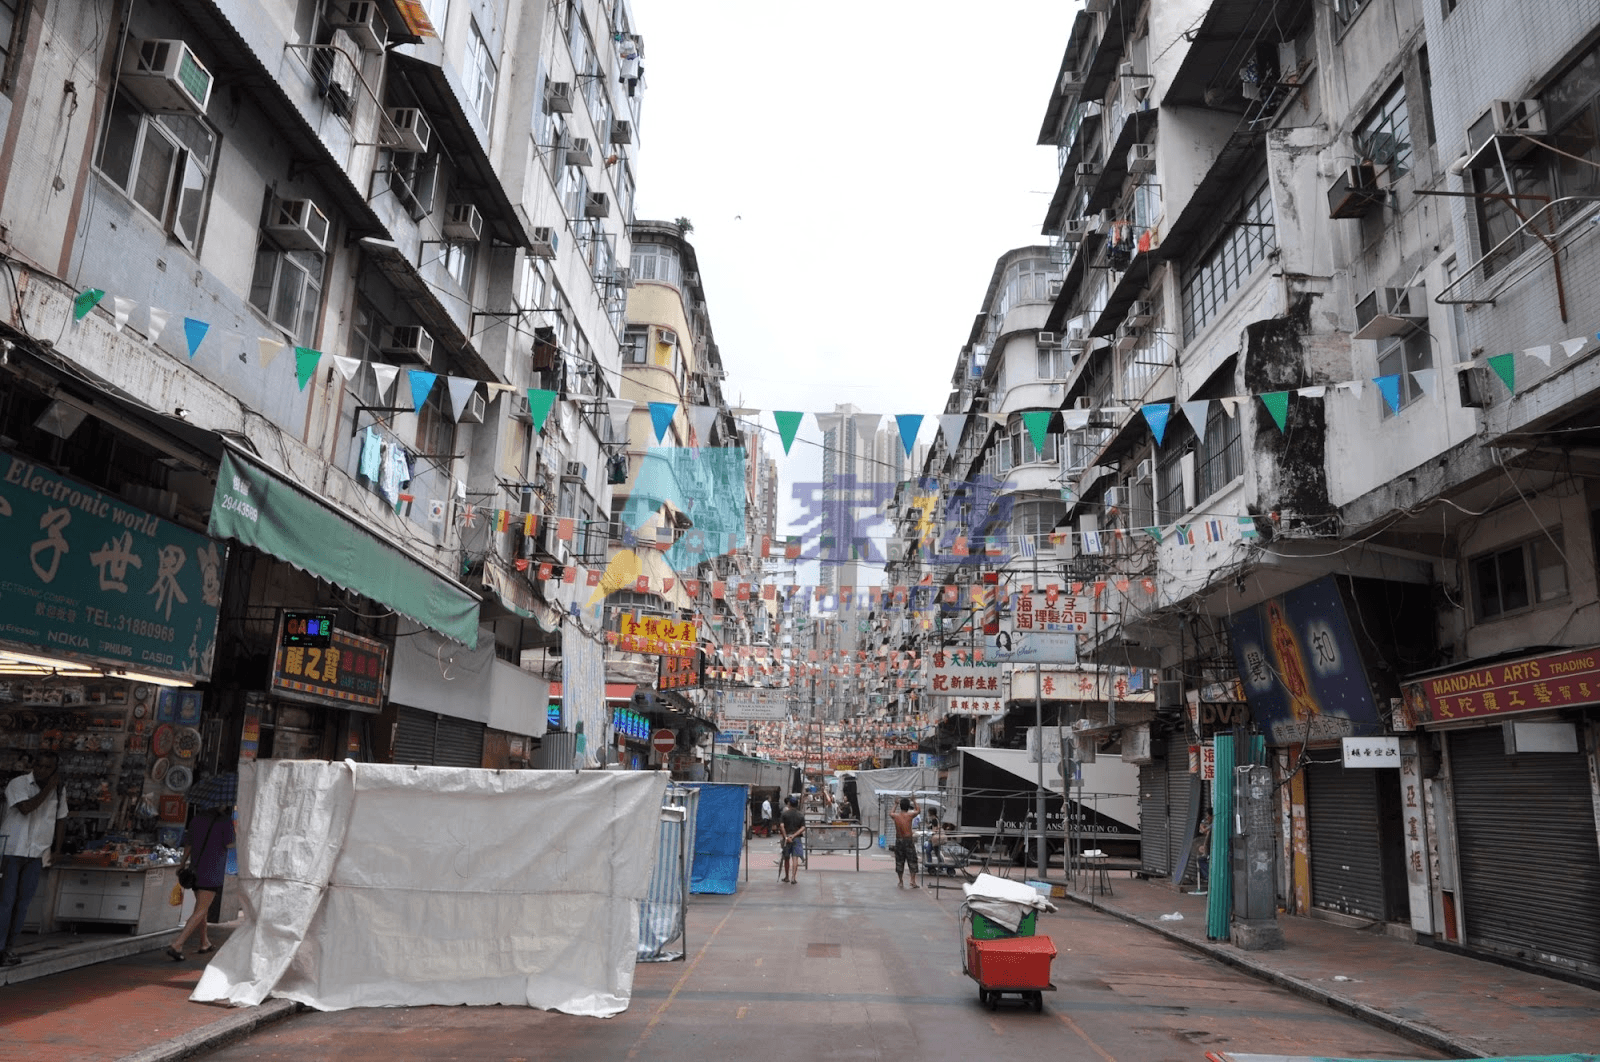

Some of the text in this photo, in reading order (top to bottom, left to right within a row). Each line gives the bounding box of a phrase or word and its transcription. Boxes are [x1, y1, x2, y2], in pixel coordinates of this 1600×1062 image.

[4, 457, 160, 537] Electronic world
[0, 495, 188, 622] 子世界
[1034, 609, 1087, 624] 理髮公司
[287, 619, 330, 636] GAME
[48, 630, 90, 648] NOKIA
[104, 641, 133, 657] PHILIPS
[142, 650, 174, 665] CASIO
[950, 675, 999, 691] 新鮮生菓
[1433, 657, 1595, 695] MANDALA ARTS TRADING
[1042, 676, 1128, 700] 春和堂
[1439, 682, 1600, 718] 曼陀羅工藝貿易
